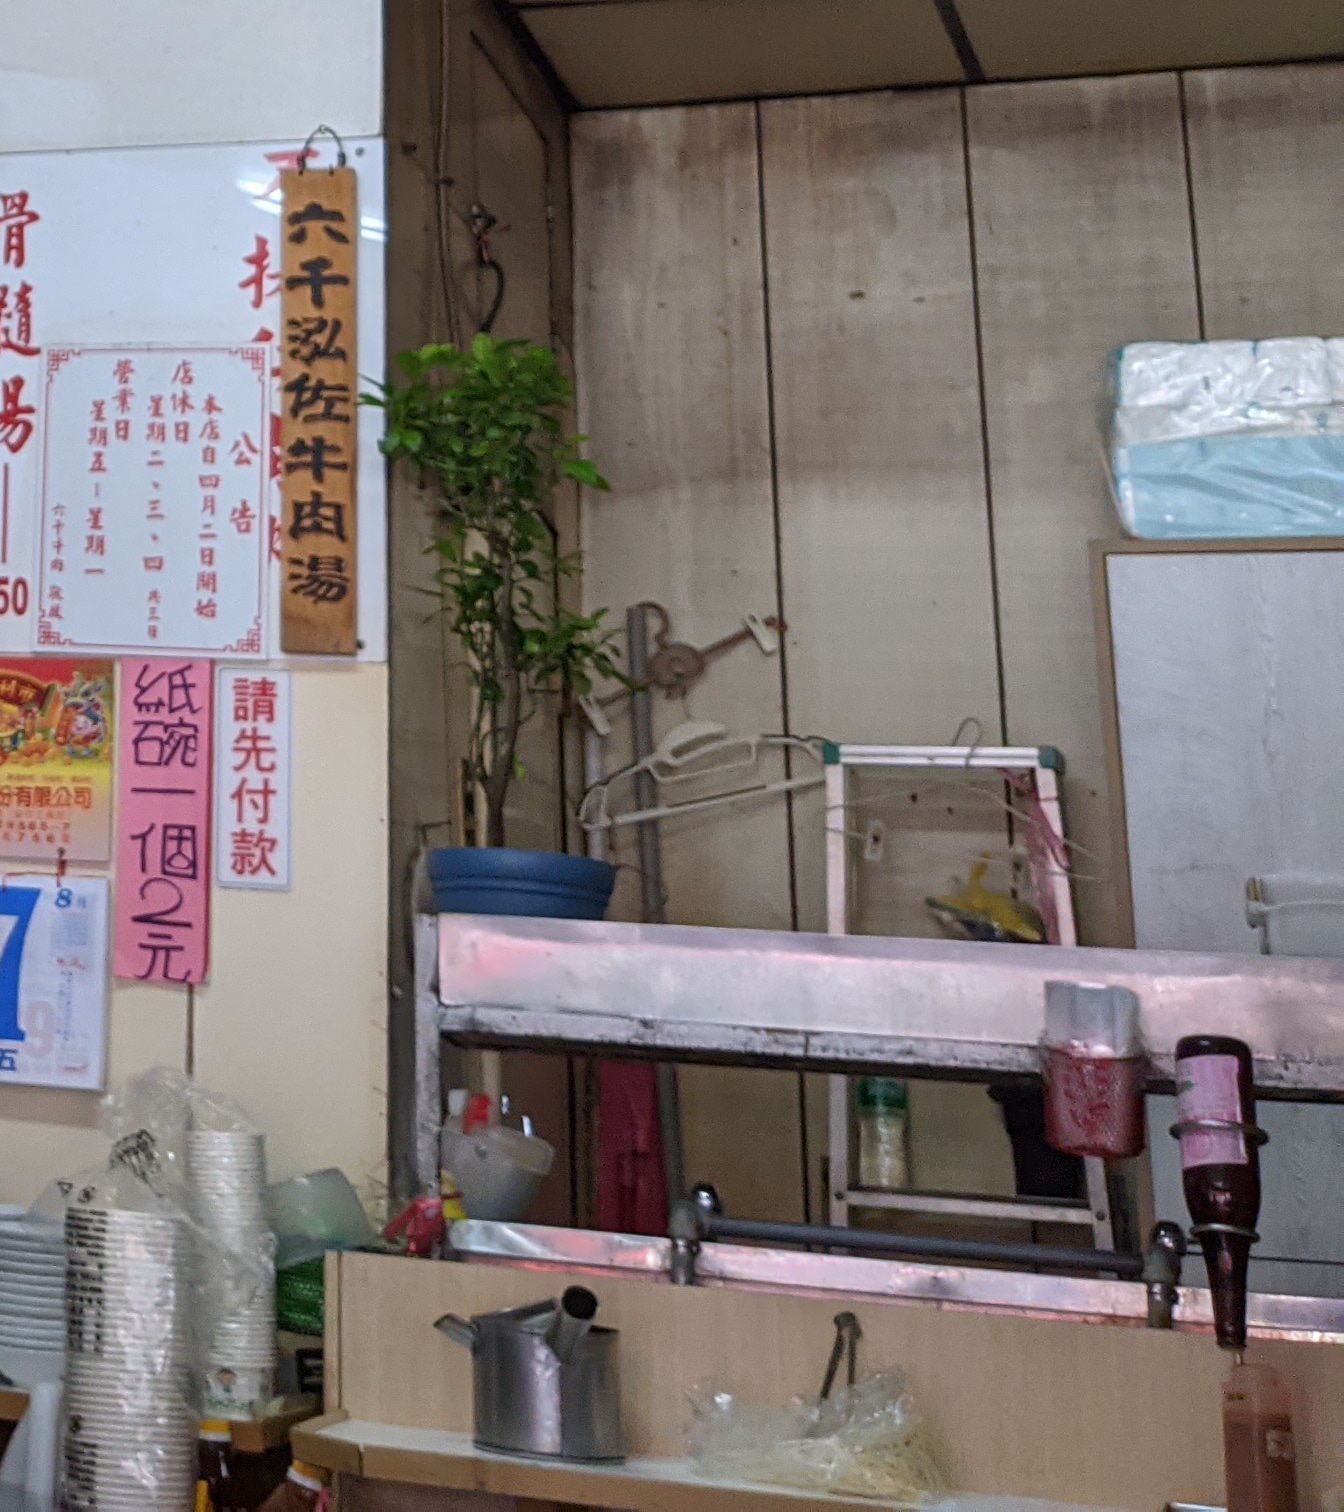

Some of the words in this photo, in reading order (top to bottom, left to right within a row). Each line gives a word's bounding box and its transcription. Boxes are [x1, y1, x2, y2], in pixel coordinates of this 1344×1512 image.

[170, 359, 195, 444] 店休日
[228, 431, 260, 535] 公告
[230, 677, 279, 877] 請先付款
